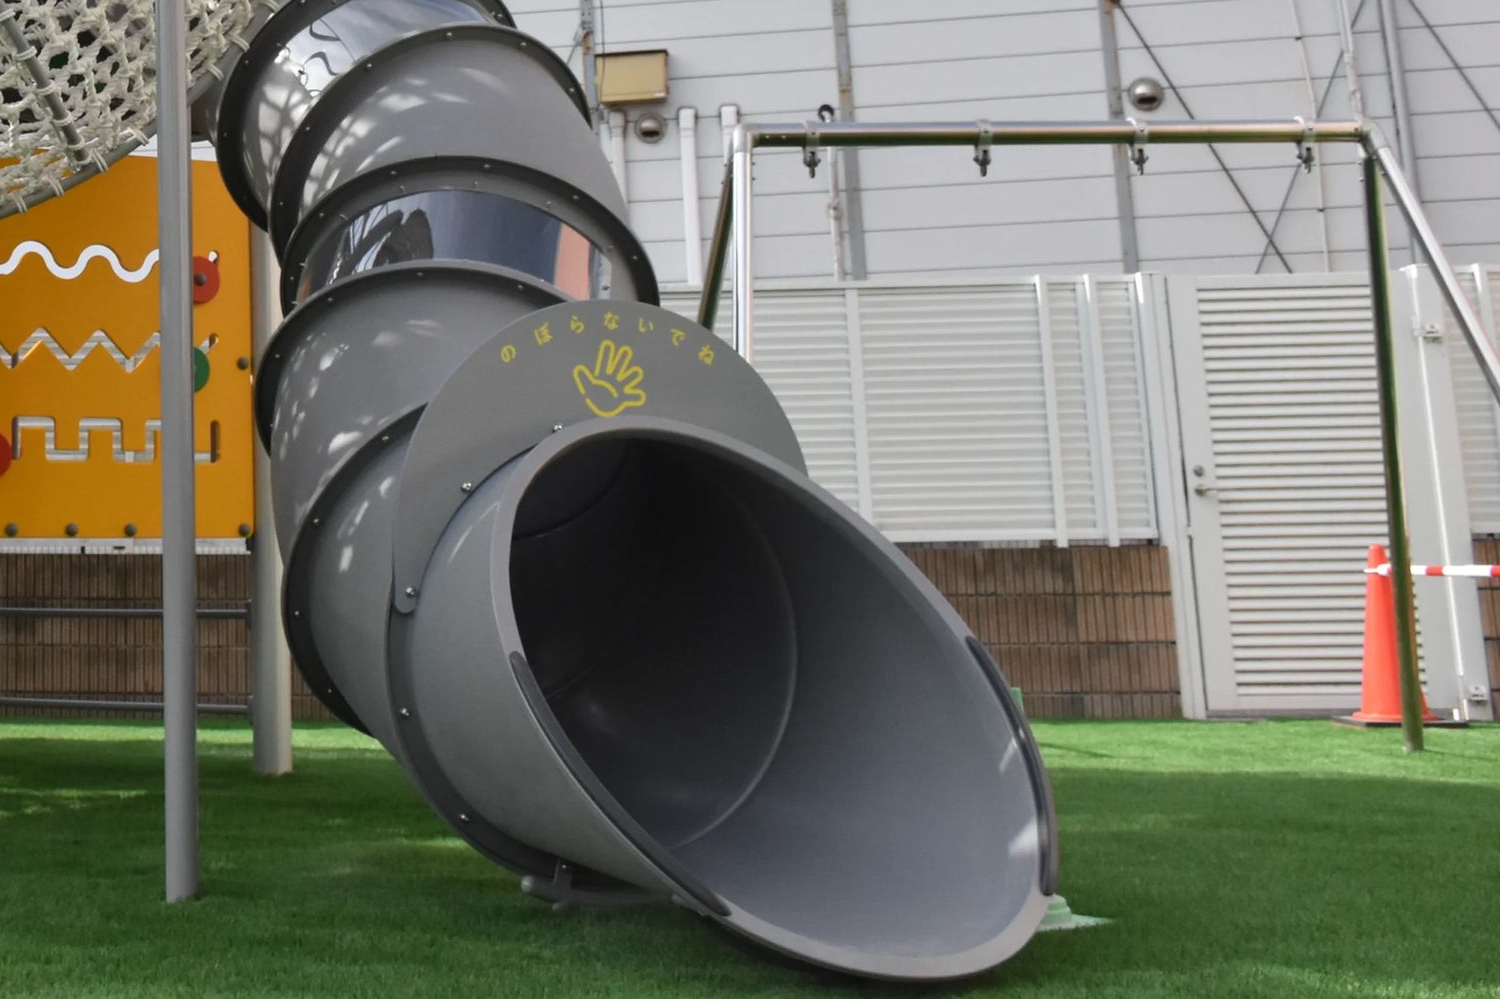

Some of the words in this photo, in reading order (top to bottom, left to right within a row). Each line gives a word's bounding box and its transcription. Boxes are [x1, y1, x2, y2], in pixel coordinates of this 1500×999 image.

[500, 310, 716, 366] のぼらないでね
